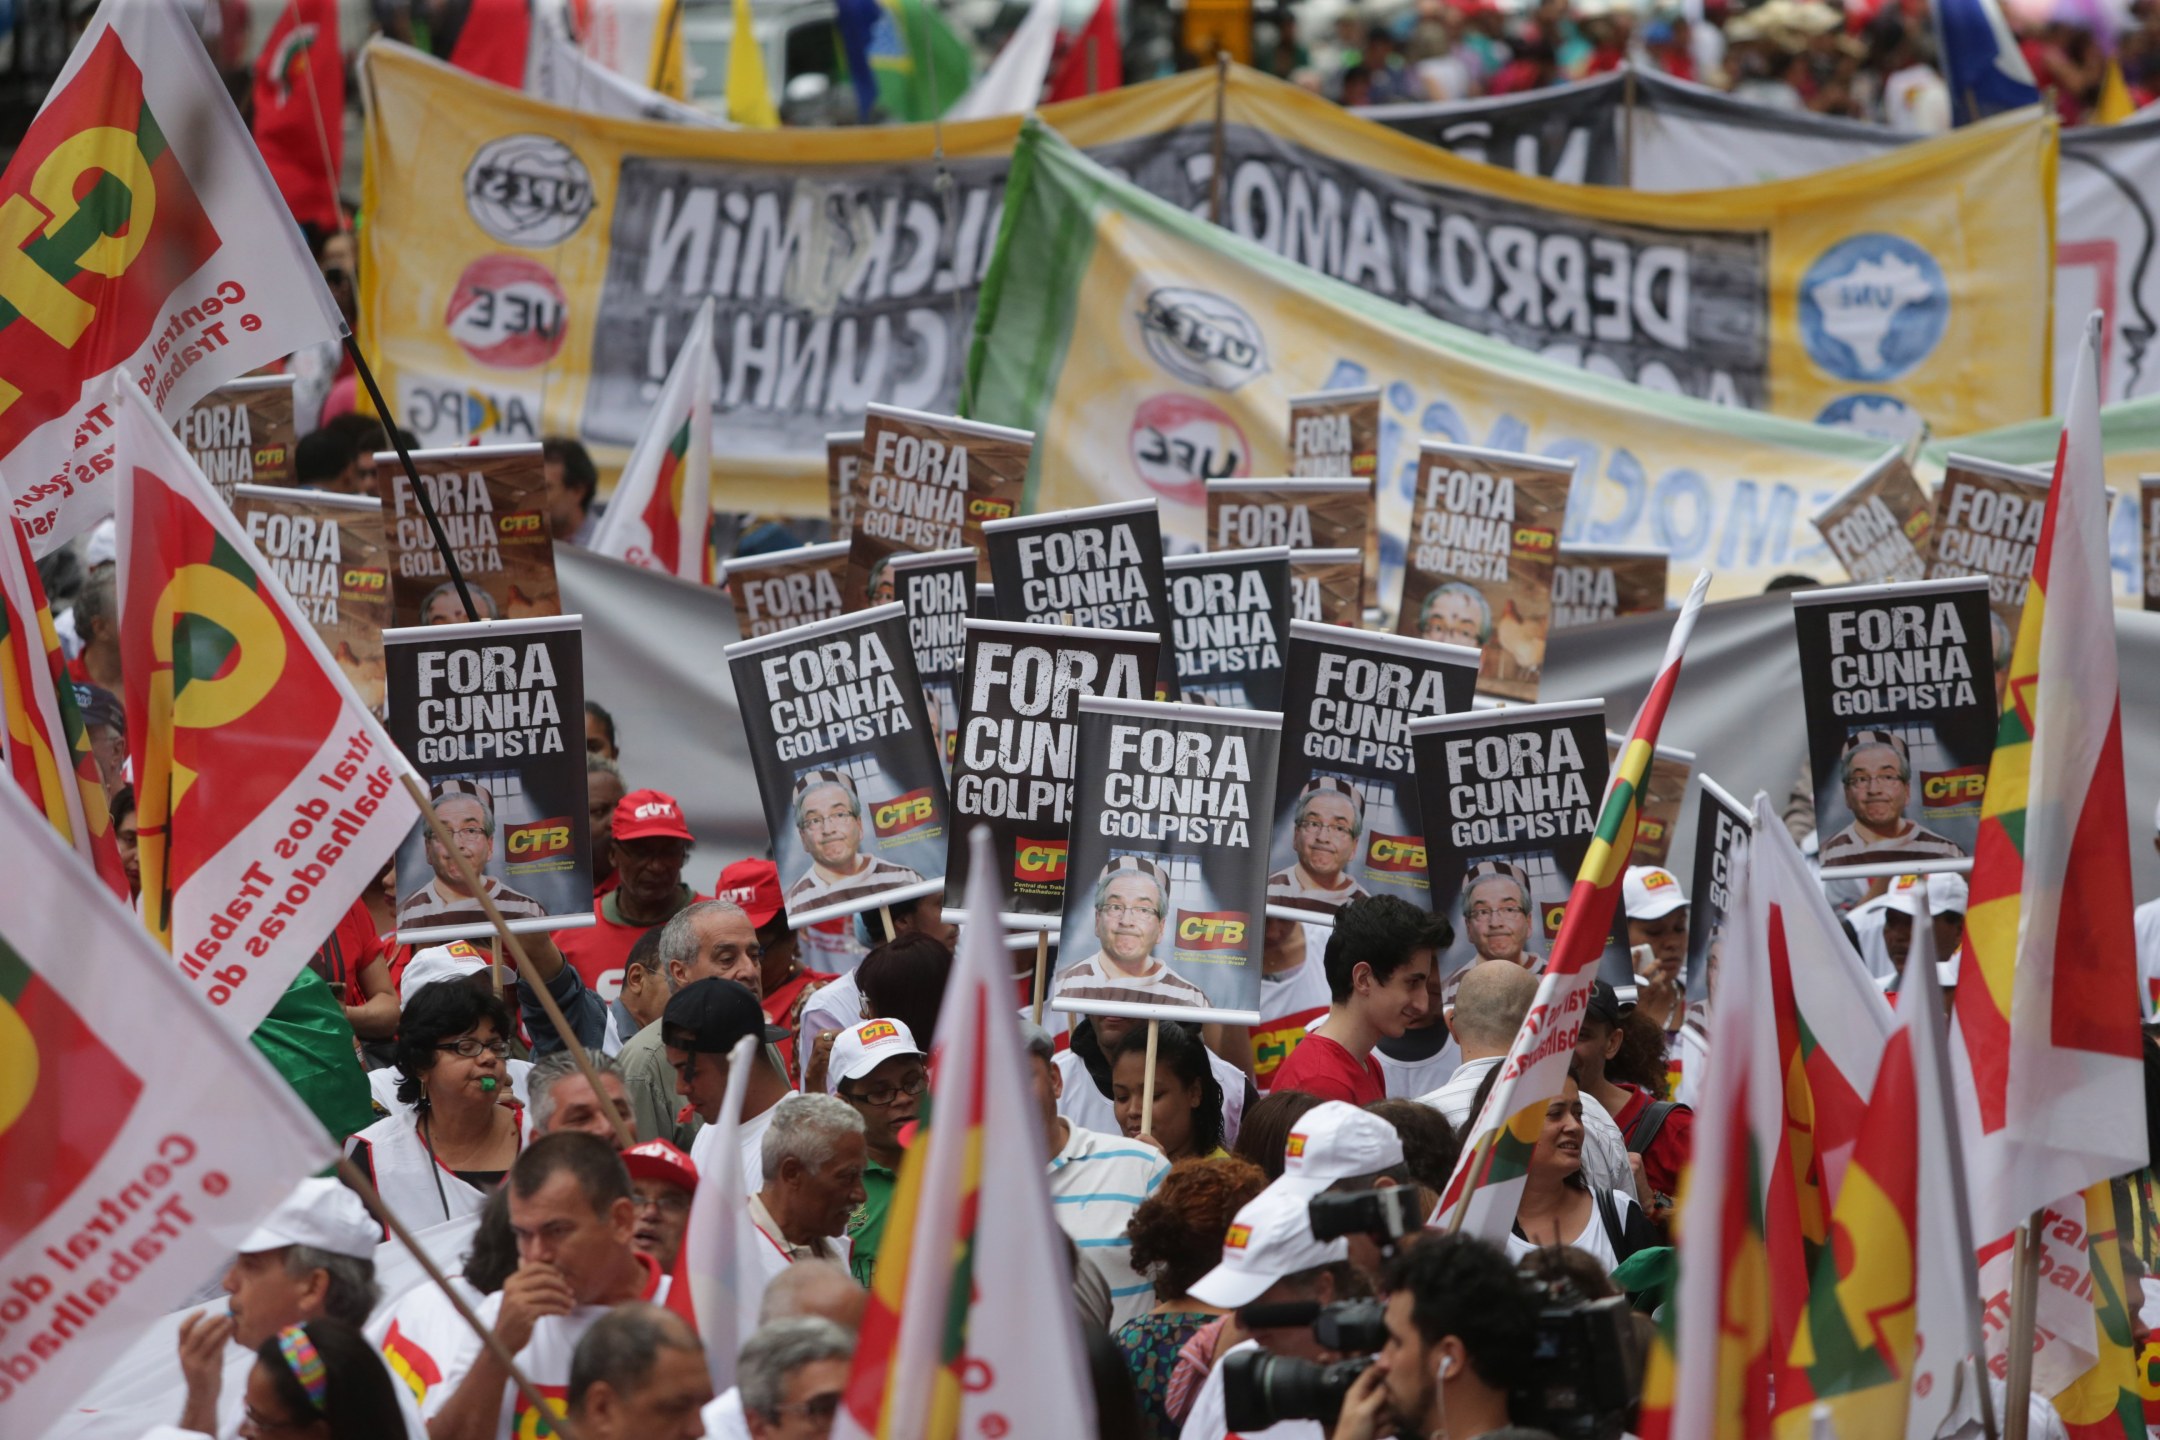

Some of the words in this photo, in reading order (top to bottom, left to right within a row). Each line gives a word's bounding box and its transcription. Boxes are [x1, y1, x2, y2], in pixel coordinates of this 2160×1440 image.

[180, 403, 253, 450] FORA
[873, 430, 969, 491] FORA
[392, 471, 493, 517] FORA
[868, 475, 965, 526] CUNHA
[969, 498, 1012, 519] CTB
[1425, 466, 1516, 522] FORA
[1947, 482, 2047, 544] FORA
[246, 511, 341, 563] FORA
[500, 513, 541, 533] CTB
[862, 509, 962, 551] GOLPISTA
[1218, 504, 1314, 548] FORA
[1420, 510, 1512, 556] CUNHA
[1016, 523, 1143, 579] FORA
[1415, 544, 1509, 582] GOLPISTA
[1938, 527, 2036, 579] CUNHA
[343, 569, 387, 591] CTB
[743, 569, 842, 621] FORA
[908, 570, 968, 617] FORA
[1022, 566, 1149, 613] CUNHA
[1165, 570, 1272, 617] ORA
[1551, 565, 1617, 608] ORA
[909, 612, 966, 649] CUNHA
[1173, 611, 1277, 652] UNHA
[1828, 602, 1967, 655] FORA
[417, 642, 557, 697] FORA
[761, 631, 894, 701] FORA
[971, 642, 1142, 719] FORA
[1176, 644, 1282, 677] OLPISTA
[1314, 652, 1446, 715] FORA
[1830, 646, 1972, 689] CUNHA
[417, 690, 561, 734] CUNHA
[769, 674, 904, 734] CUNHA
[1309, 698, 1413, 745] CUNH
[1832, 681, 1976, 716] GOLPISTA
[417, 726, 564, 763] GOLPISTA
[775, 706, 912, 762] GOLPISTA
[963, 717, 1077, 779] CUN
[1108, 725, 1251, 782] FORA
[1303, 732, 1415, 774] GOLPIST
[1445, 727, 1585, 784] FORA
[957, 774, 1074, 824] GOLPI
[1104, 772, 1250, 819] CUNHA
[1449, 773, 1591, 819] CUNHA
[1925, 774, 1985, 799] CTB
[634, 803, 675, 820] CUT
[875, 796, 933, 829] CTB
[1099, 810, 1250, 848] GOLPISTA
[1451, 807, 1594, 847] GOLPISTA
[508, 826, 570, 854] CTB
[1020, 846, 1067, 872] CT
[1371, 839, 1428, 867] CTB
[1180, 917, 1245, 944] CTB
[861, 1023, 895, 1040] CTB
